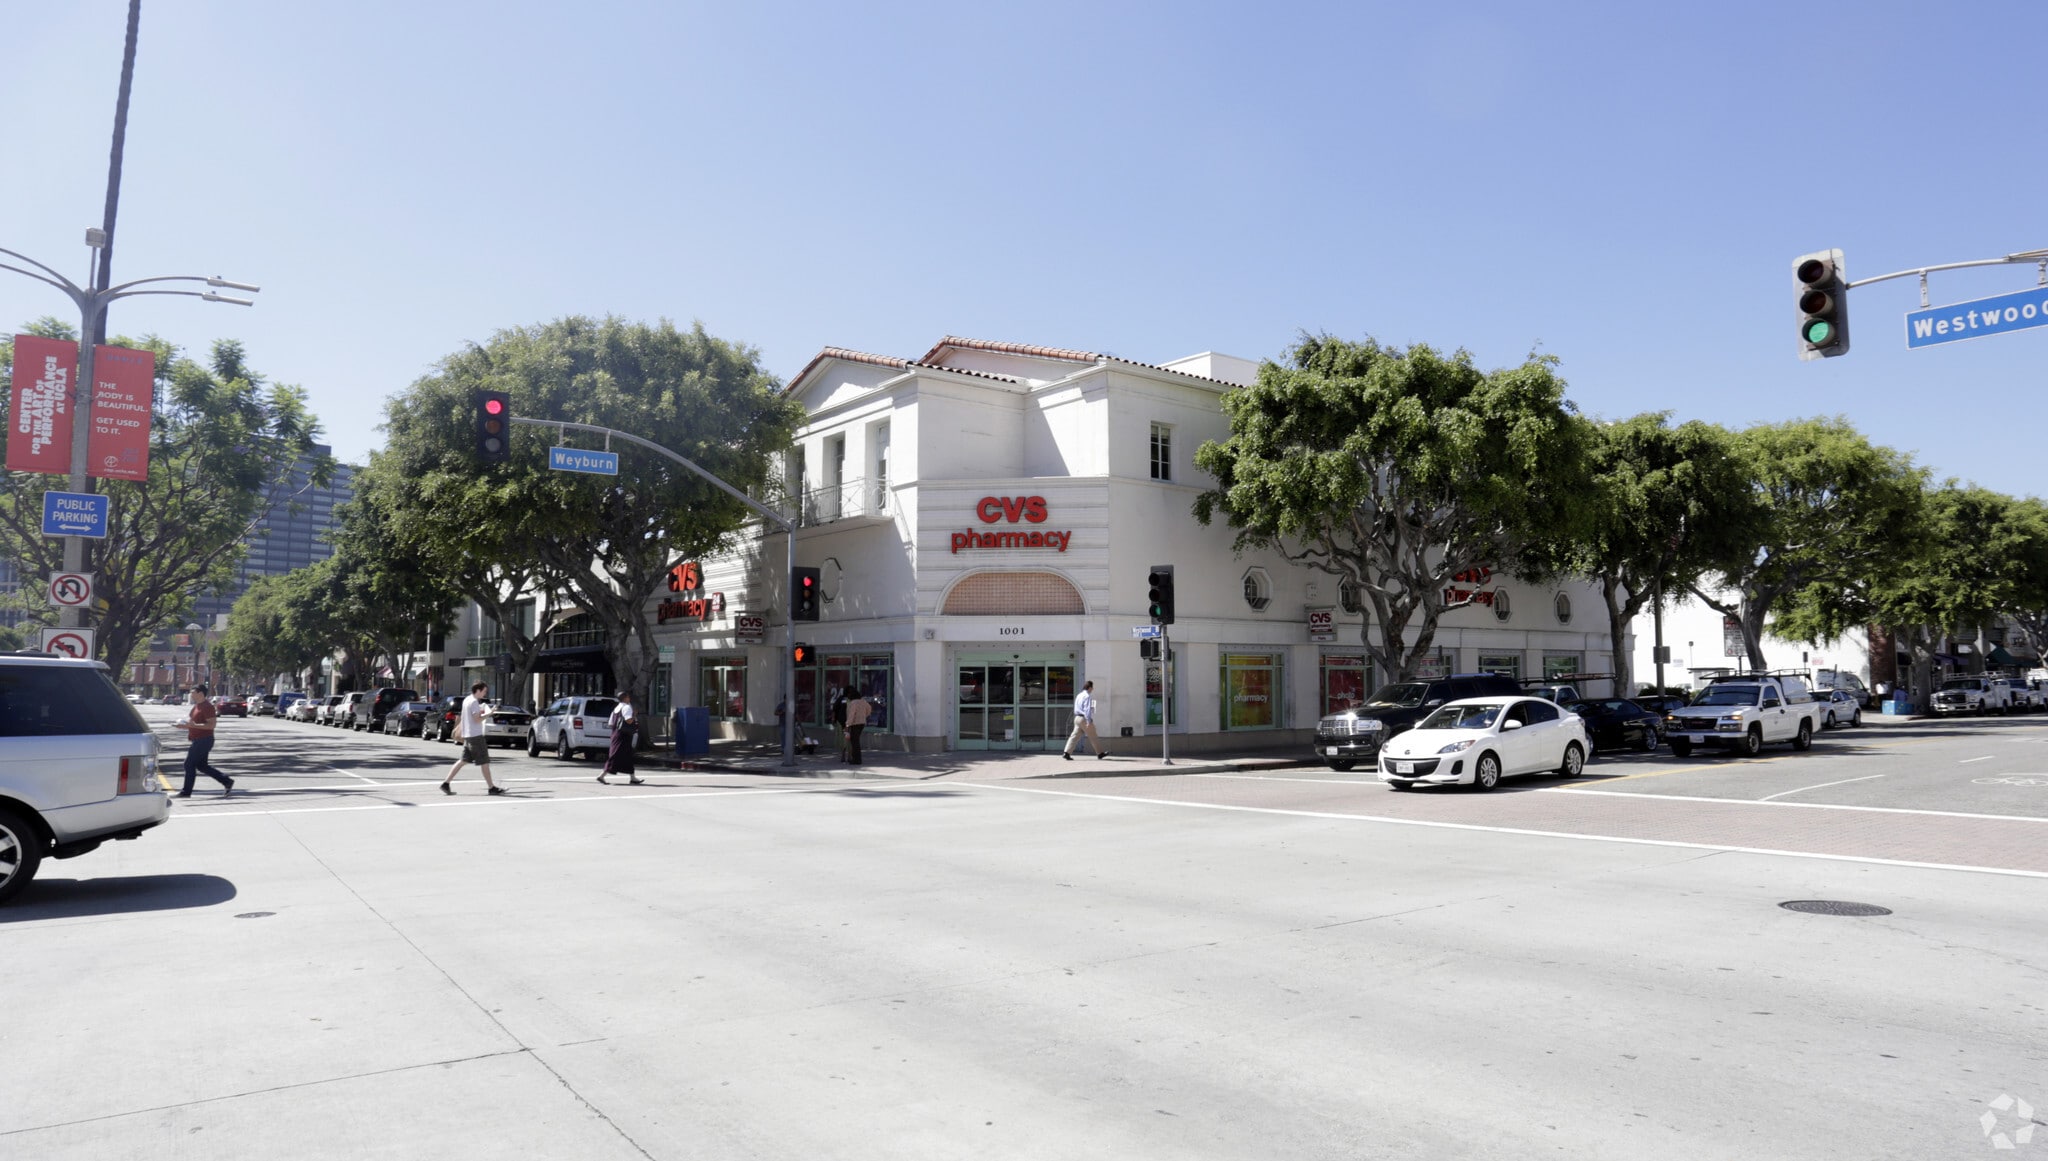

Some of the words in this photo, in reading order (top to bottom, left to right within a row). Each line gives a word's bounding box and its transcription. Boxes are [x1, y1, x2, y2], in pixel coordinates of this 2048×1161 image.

[36, 380, 44, 391] OF
[55, 367, 67, 401] UCLA
[99, 381, 117, 390] THE
[40, 356, 57, 444] PERFORMANCE
[96, 391, 123, 401] BODY
[19, 388, 33, 433] CENTER
[32, 391, 43, 419] ART
[56, 402, 65, 414] AT
[97, 401, 148, 412] BEAUTIFUL.
[33, 419, 42, 435] THE
[96, 417, 113, 425] GET
[116, 418, 140, 428] USED
[96, 426, 108, 434] TO
[111, 427, 121, 435] IT.
[32, 437, 41, 455] FOR
[555, 452, 613, 470] Weyburn
[57, 498, 96, 511] PUBLIC
[977, 495, 1048, 523] CVS
[52, 511, 98, 524] PARKING
[951, 527, 1072, 554] pharmacy
[668, 561, 698, 592] CVS
[657, 598, 707, 624] pharmacy
[1310, 612, 1332, 623] CVS
[740, 617, 763, 628] CVS
[1000, 627, 1025, 635] 1001
[1233, 694, 1268, 704] pharmacy
